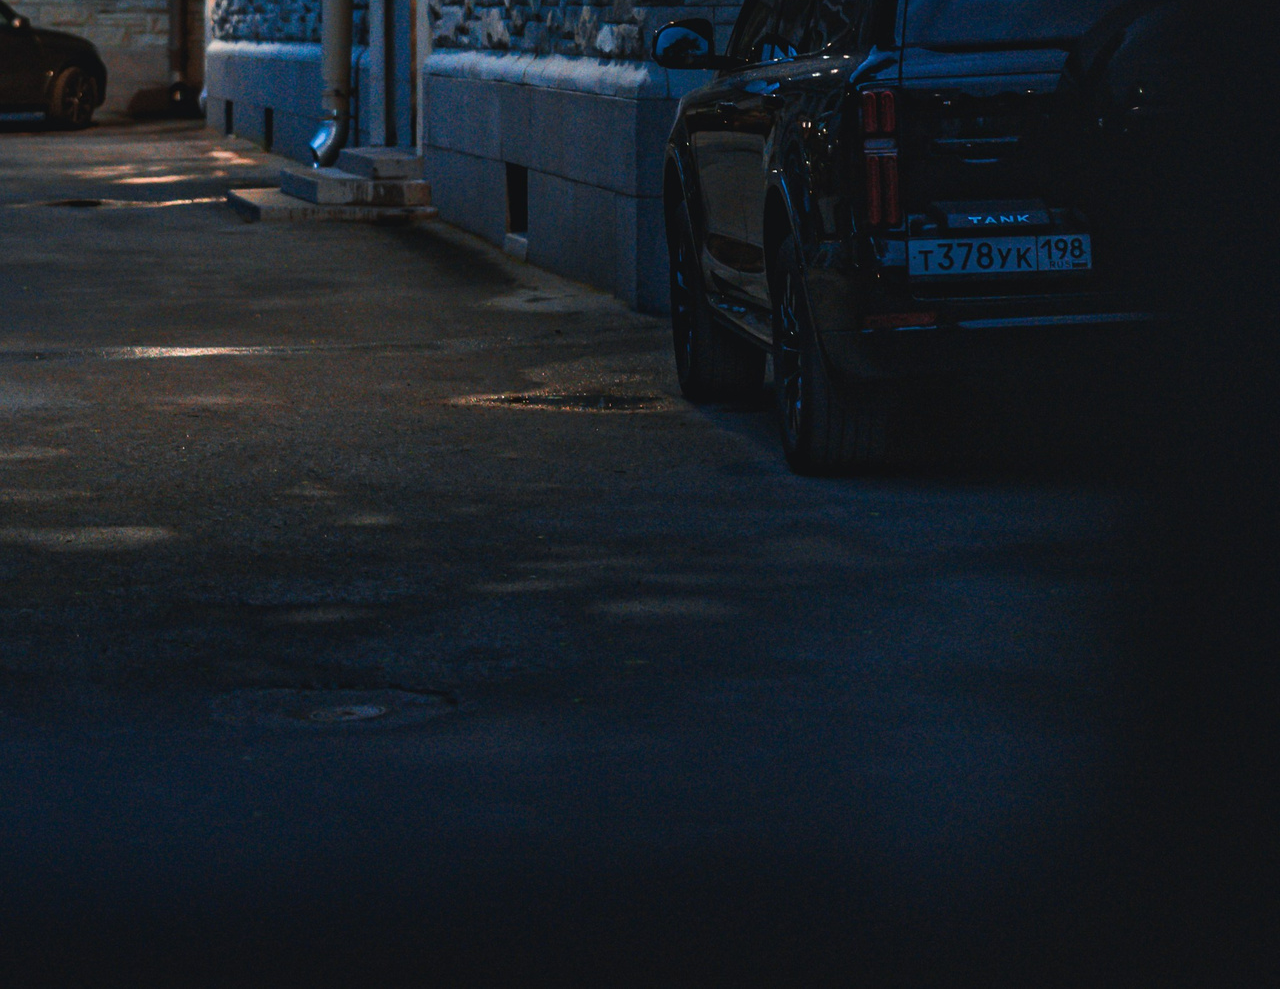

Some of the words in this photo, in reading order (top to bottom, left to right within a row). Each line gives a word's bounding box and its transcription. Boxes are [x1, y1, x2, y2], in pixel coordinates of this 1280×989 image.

[968, 214, 1030, 225] TANK
[1040, 238, 1084, 260] 198
[1049, 260, 1070, 269] RUS
